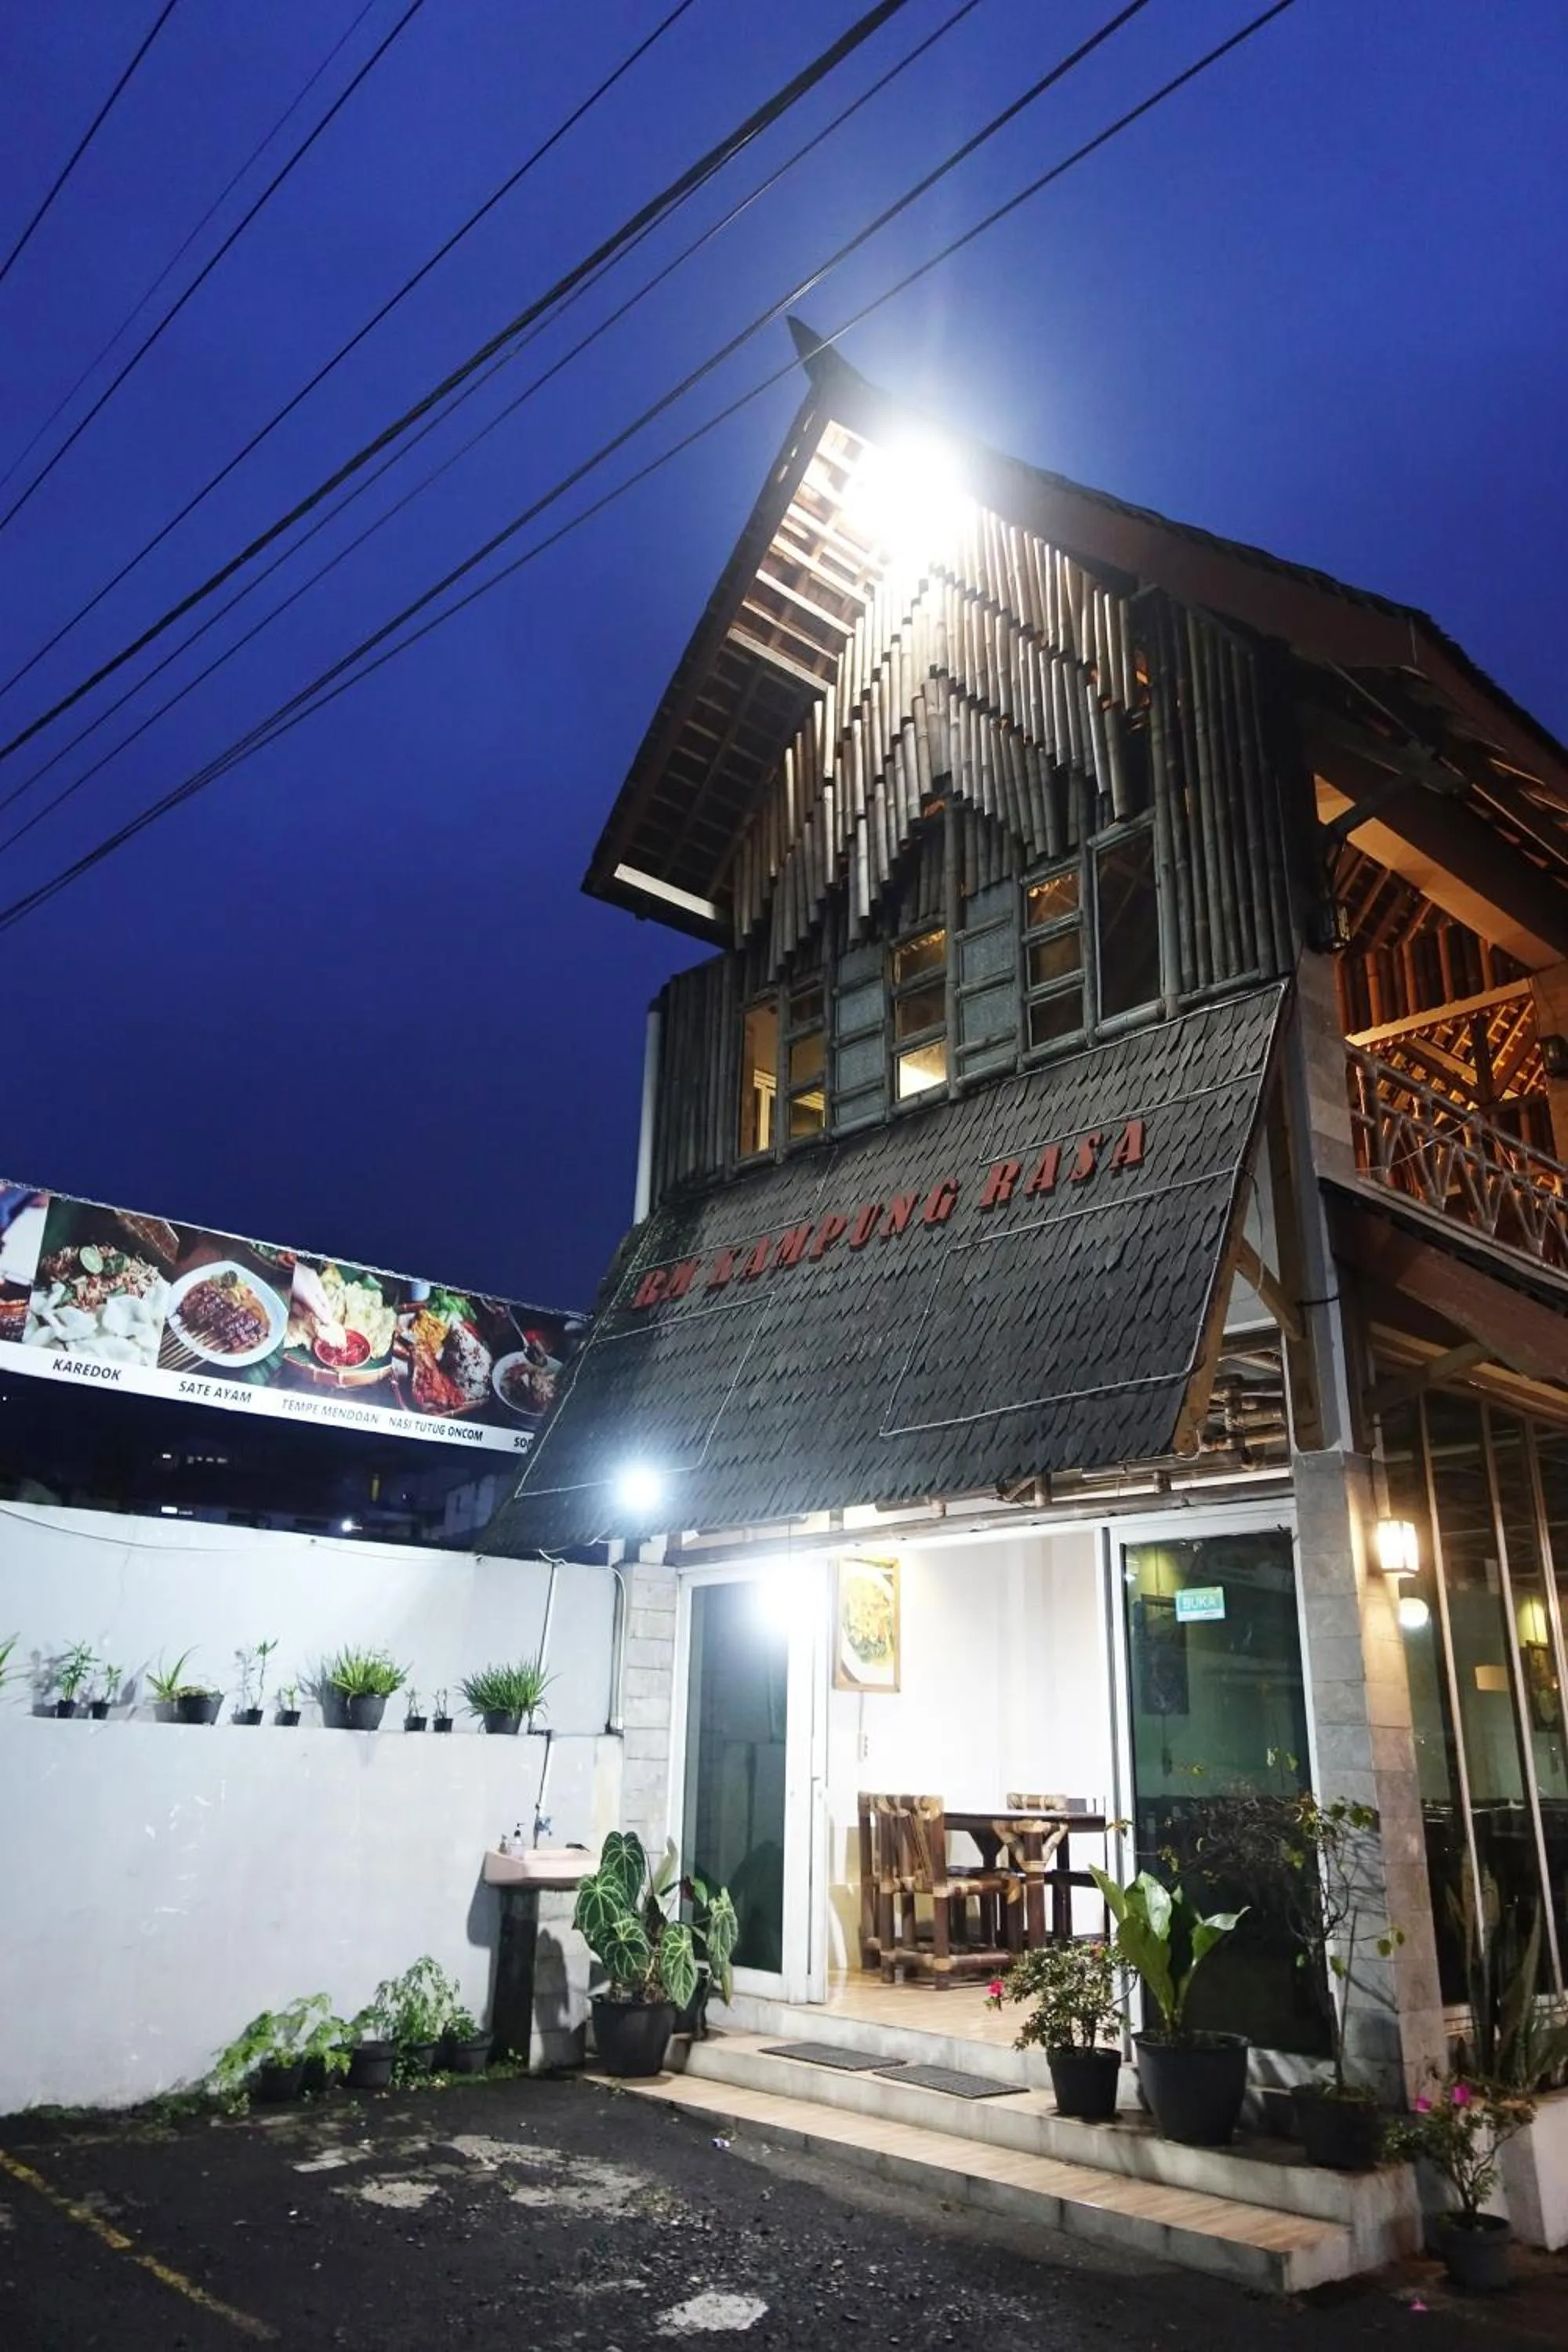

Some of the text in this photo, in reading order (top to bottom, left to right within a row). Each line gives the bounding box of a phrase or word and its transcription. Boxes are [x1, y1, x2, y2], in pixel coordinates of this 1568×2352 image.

[632, 1119, 1145, 1309] RM KAMPUNG RASA
[53, 1358, 121, 1381] KAREDOK
[179, 1381, 252, 1403] SATE AYAM
[282, 1398, 379, 1425] TEMPE MENDOAN
[389, 1416, 483, 1442] NASI TUTUG ONCOM
[1182, 1595, 1218, 1610] BUKA
